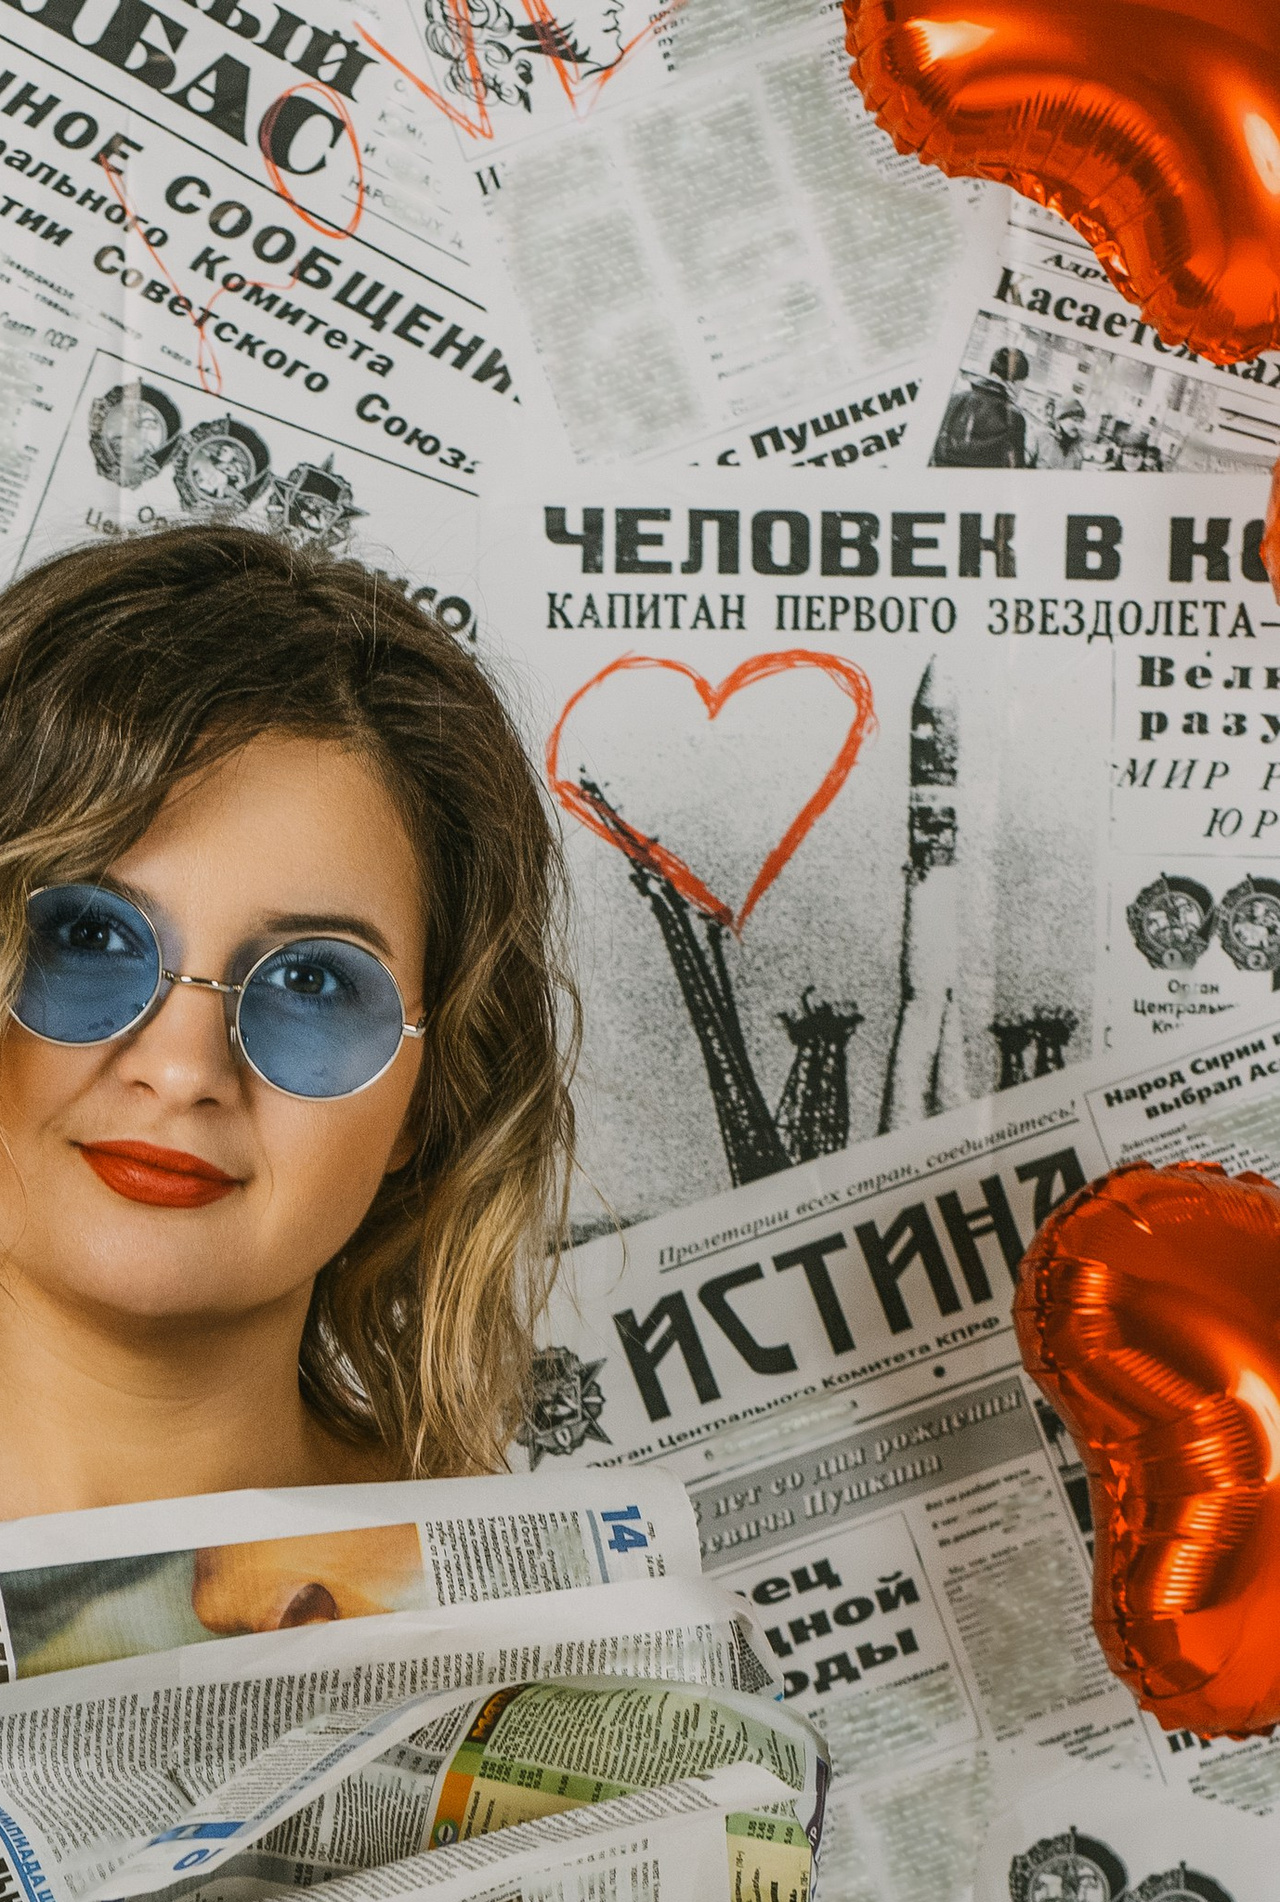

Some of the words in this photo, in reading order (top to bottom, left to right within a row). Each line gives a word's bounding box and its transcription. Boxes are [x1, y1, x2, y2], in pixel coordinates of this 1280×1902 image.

[92, 243, 329, 396] Советского
[187, 245, 395, 379] Комитета
[544, 505, 1018, 579] ЧЕЛОВЕК
[1065, 514, 1122, 581] В
[546, 592, 748, 631] КАПИТАН
[775, 595, 956, 635] ПЕРВОГО
[1103, 1062, 1184, 1109] Народ
[1192, 1036, 1265, 1078] Сирии
[1145, 1077, 1245, 1123] выбрал
[657, 1200, 789, 1267] Пролетарии
[797, 1186, 841, 1219] всех
[847, 1159, 920, 1200] стран,
[927, 1100, 1078, 1170] соединяйтесь!
[658, 1383, 817, 1455] Центрального
[822, 1345, 932, 1389] Комитета
[936, 1317, 1000, 1347] КПРФ
[875, 1390, 1021, 1463] рождения
[803, 1455, 943, 1519] Пушкина
[601, 1505, 648, 1553] 14
